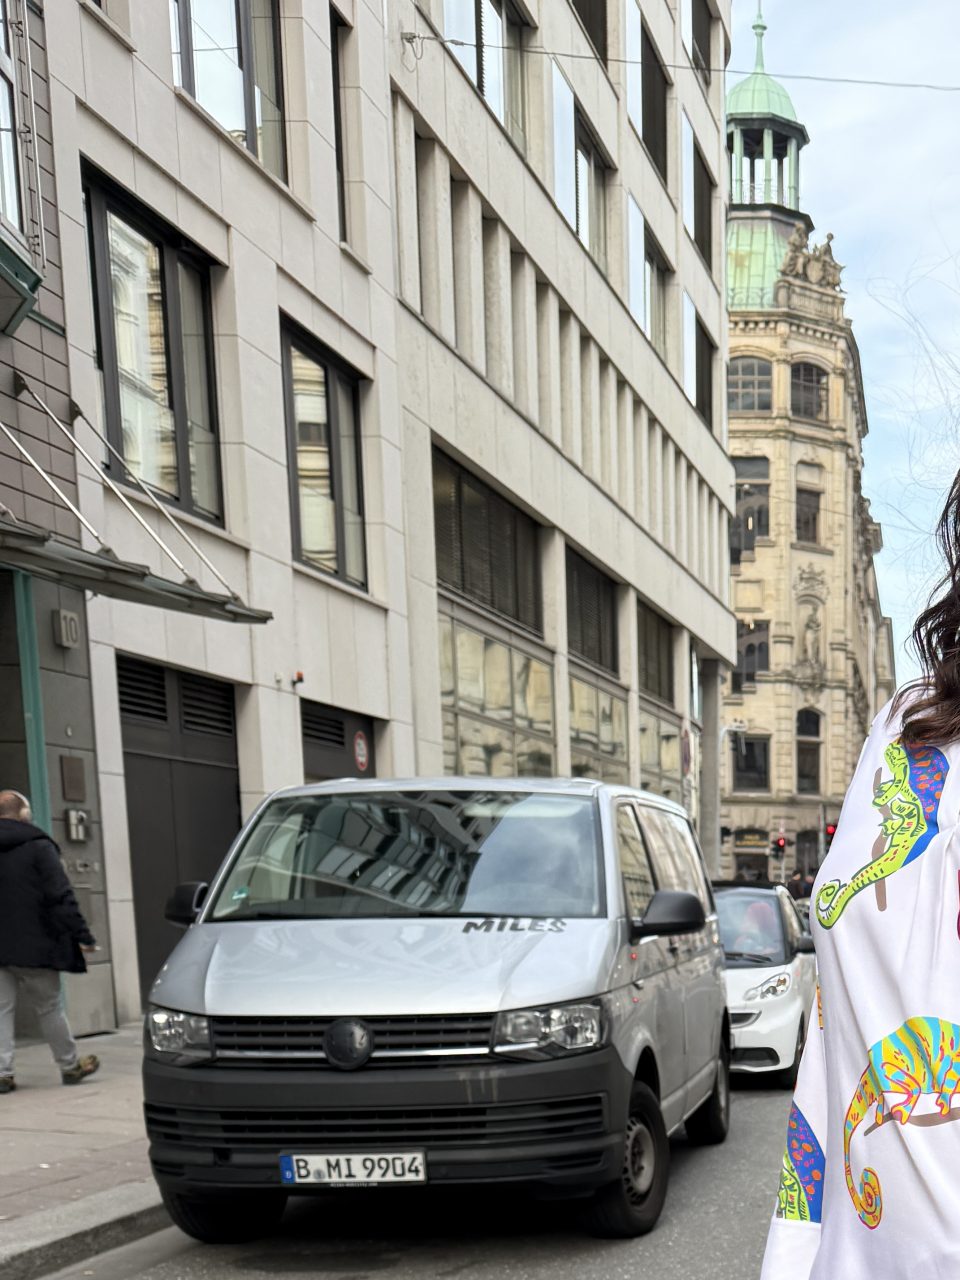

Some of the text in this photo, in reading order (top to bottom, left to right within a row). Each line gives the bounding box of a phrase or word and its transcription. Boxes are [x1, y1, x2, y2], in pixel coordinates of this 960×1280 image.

[62, 614, 79, 644] 10
[462, 918, 567, 933] MILES
[295, 1157, 421, 1179] B MI 9904
